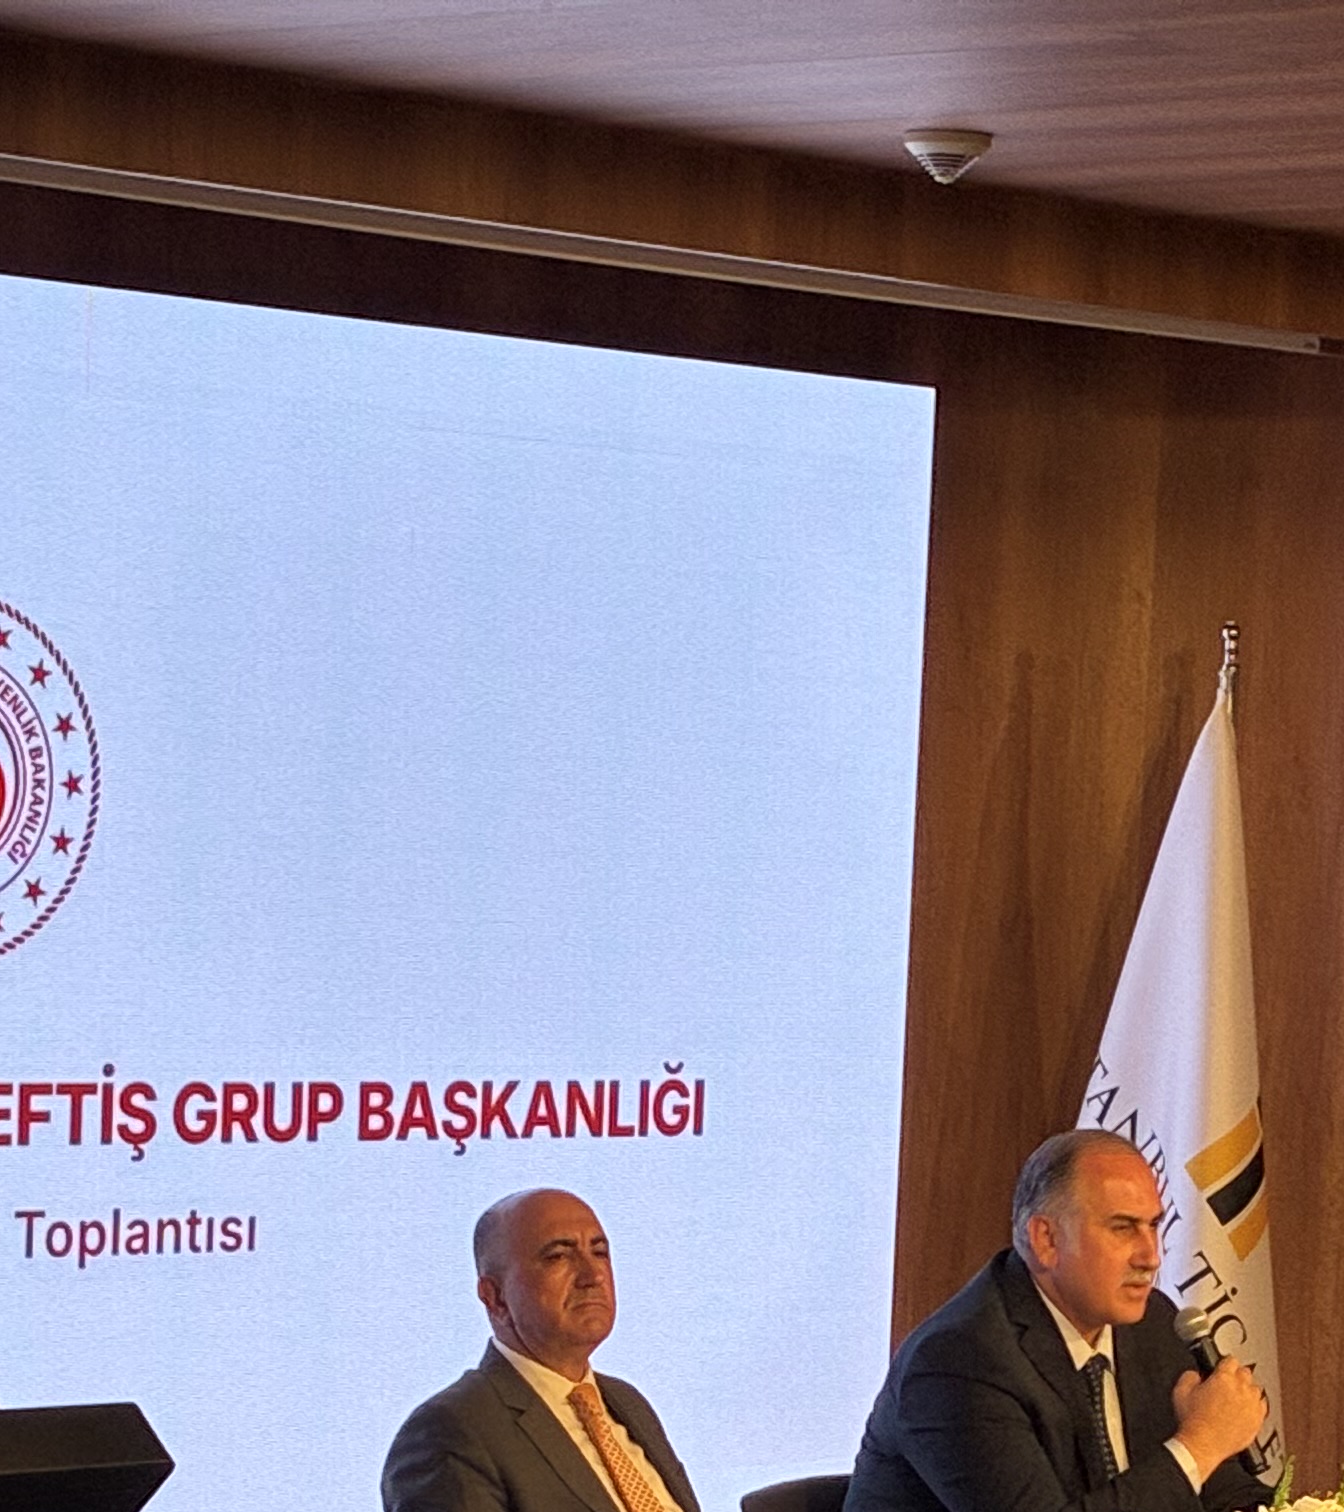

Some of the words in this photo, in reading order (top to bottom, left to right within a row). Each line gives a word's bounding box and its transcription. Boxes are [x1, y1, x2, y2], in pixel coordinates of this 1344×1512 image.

[7, 745, 47, 865] BAKANLIĞI
[172, 1079, 344, 1146] GRUP
[356, 1061, 707, 1157] BAŞKANLIĞI
[14, 1208, 258, 1269] Toplantısı
